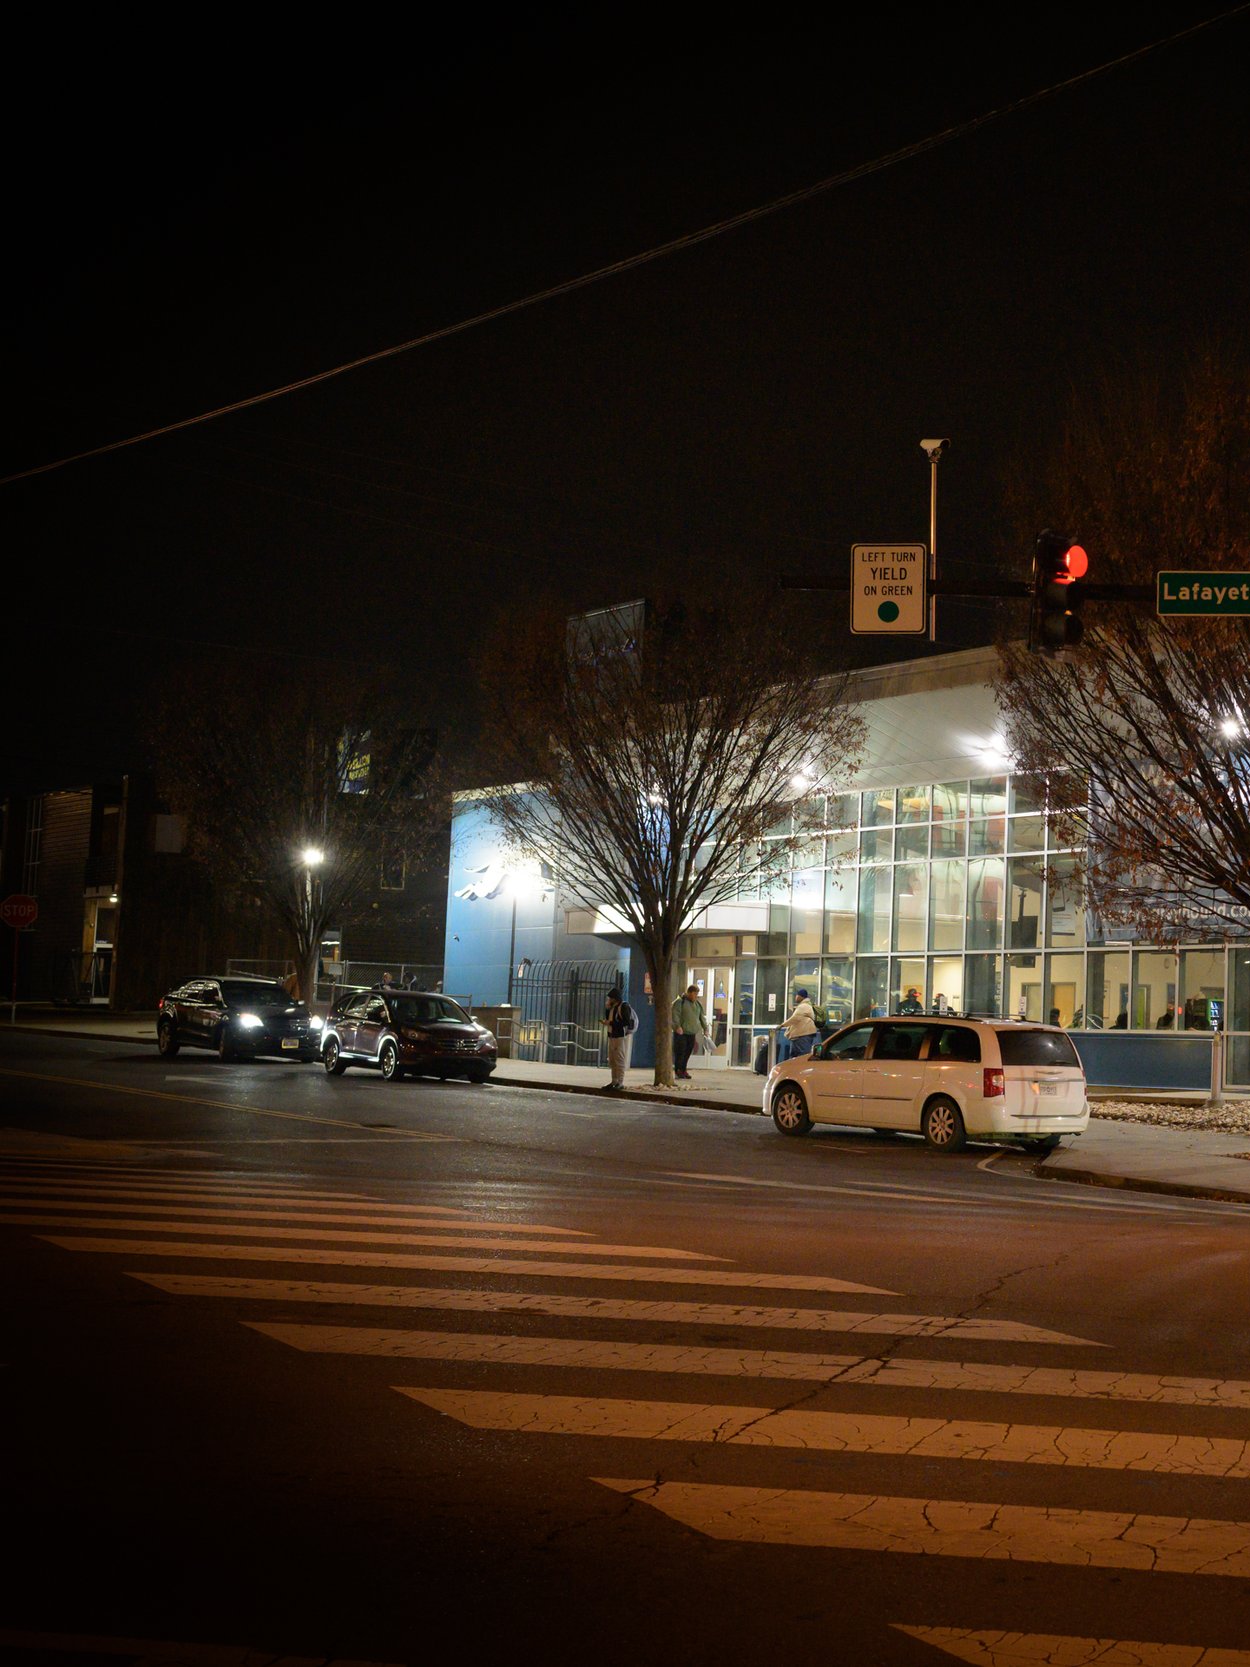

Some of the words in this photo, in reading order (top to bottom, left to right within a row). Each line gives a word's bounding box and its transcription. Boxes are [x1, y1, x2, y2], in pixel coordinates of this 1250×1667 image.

[862, 552, 886, 562] LEFT
[891, 552, 916, 562] TURN
[870, 567, 907, 580] YIELD
[864, 585, 877, 596] ON
[881, 585, 913, 596] GREEN
[4, 904, 35, 917] STOP
